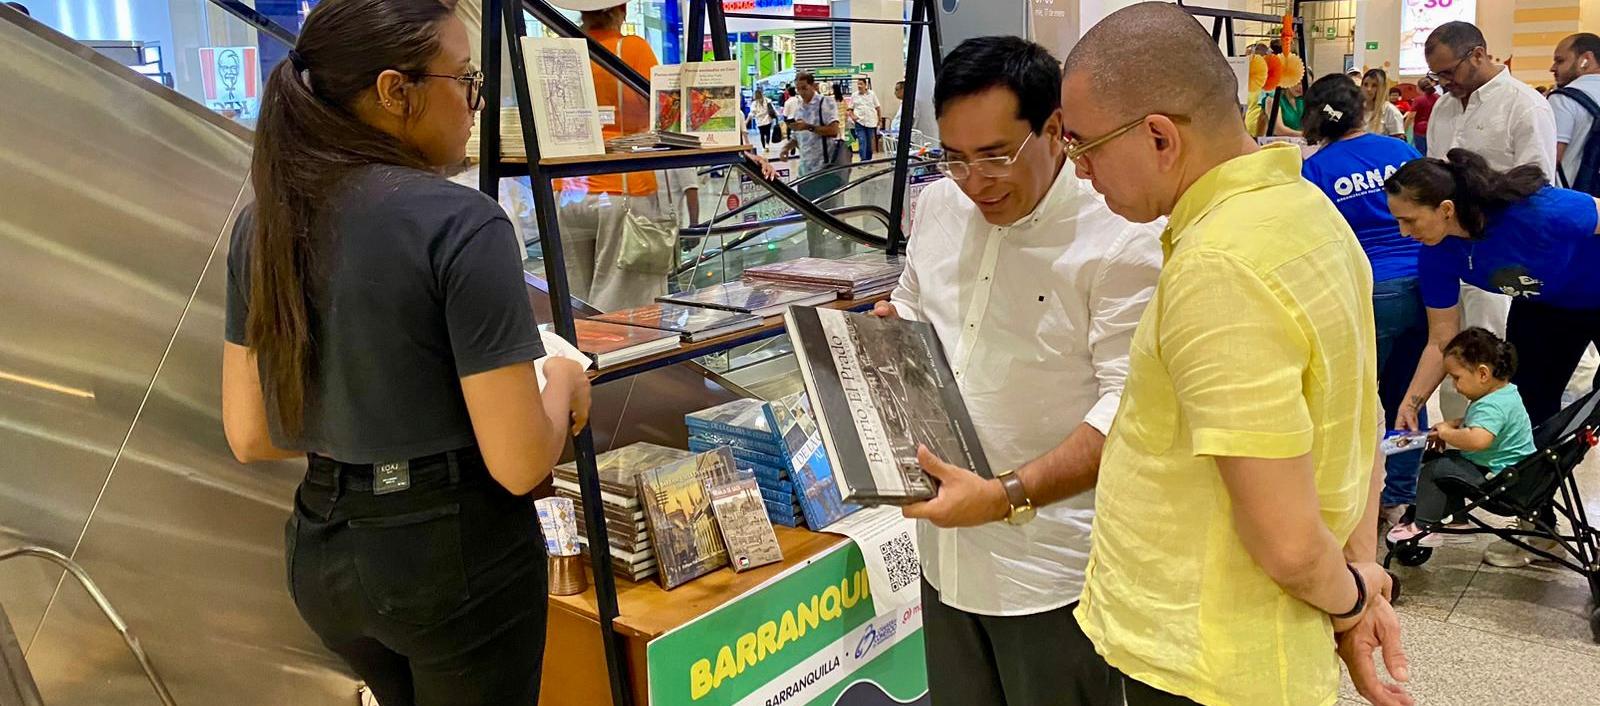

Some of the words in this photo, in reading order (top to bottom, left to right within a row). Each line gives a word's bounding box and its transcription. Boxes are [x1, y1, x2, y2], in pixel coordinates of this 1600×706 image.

[1334, 161, 1406, 196] ORNA
[831, 335, 856, 381] Prado
[845, 386, 862, 403] El
[857, 408, 883, 463] Barrio
[690, 567, 869, 701] BARRANQUI
[765, 655, 840, 706] BARRANQUILLA
